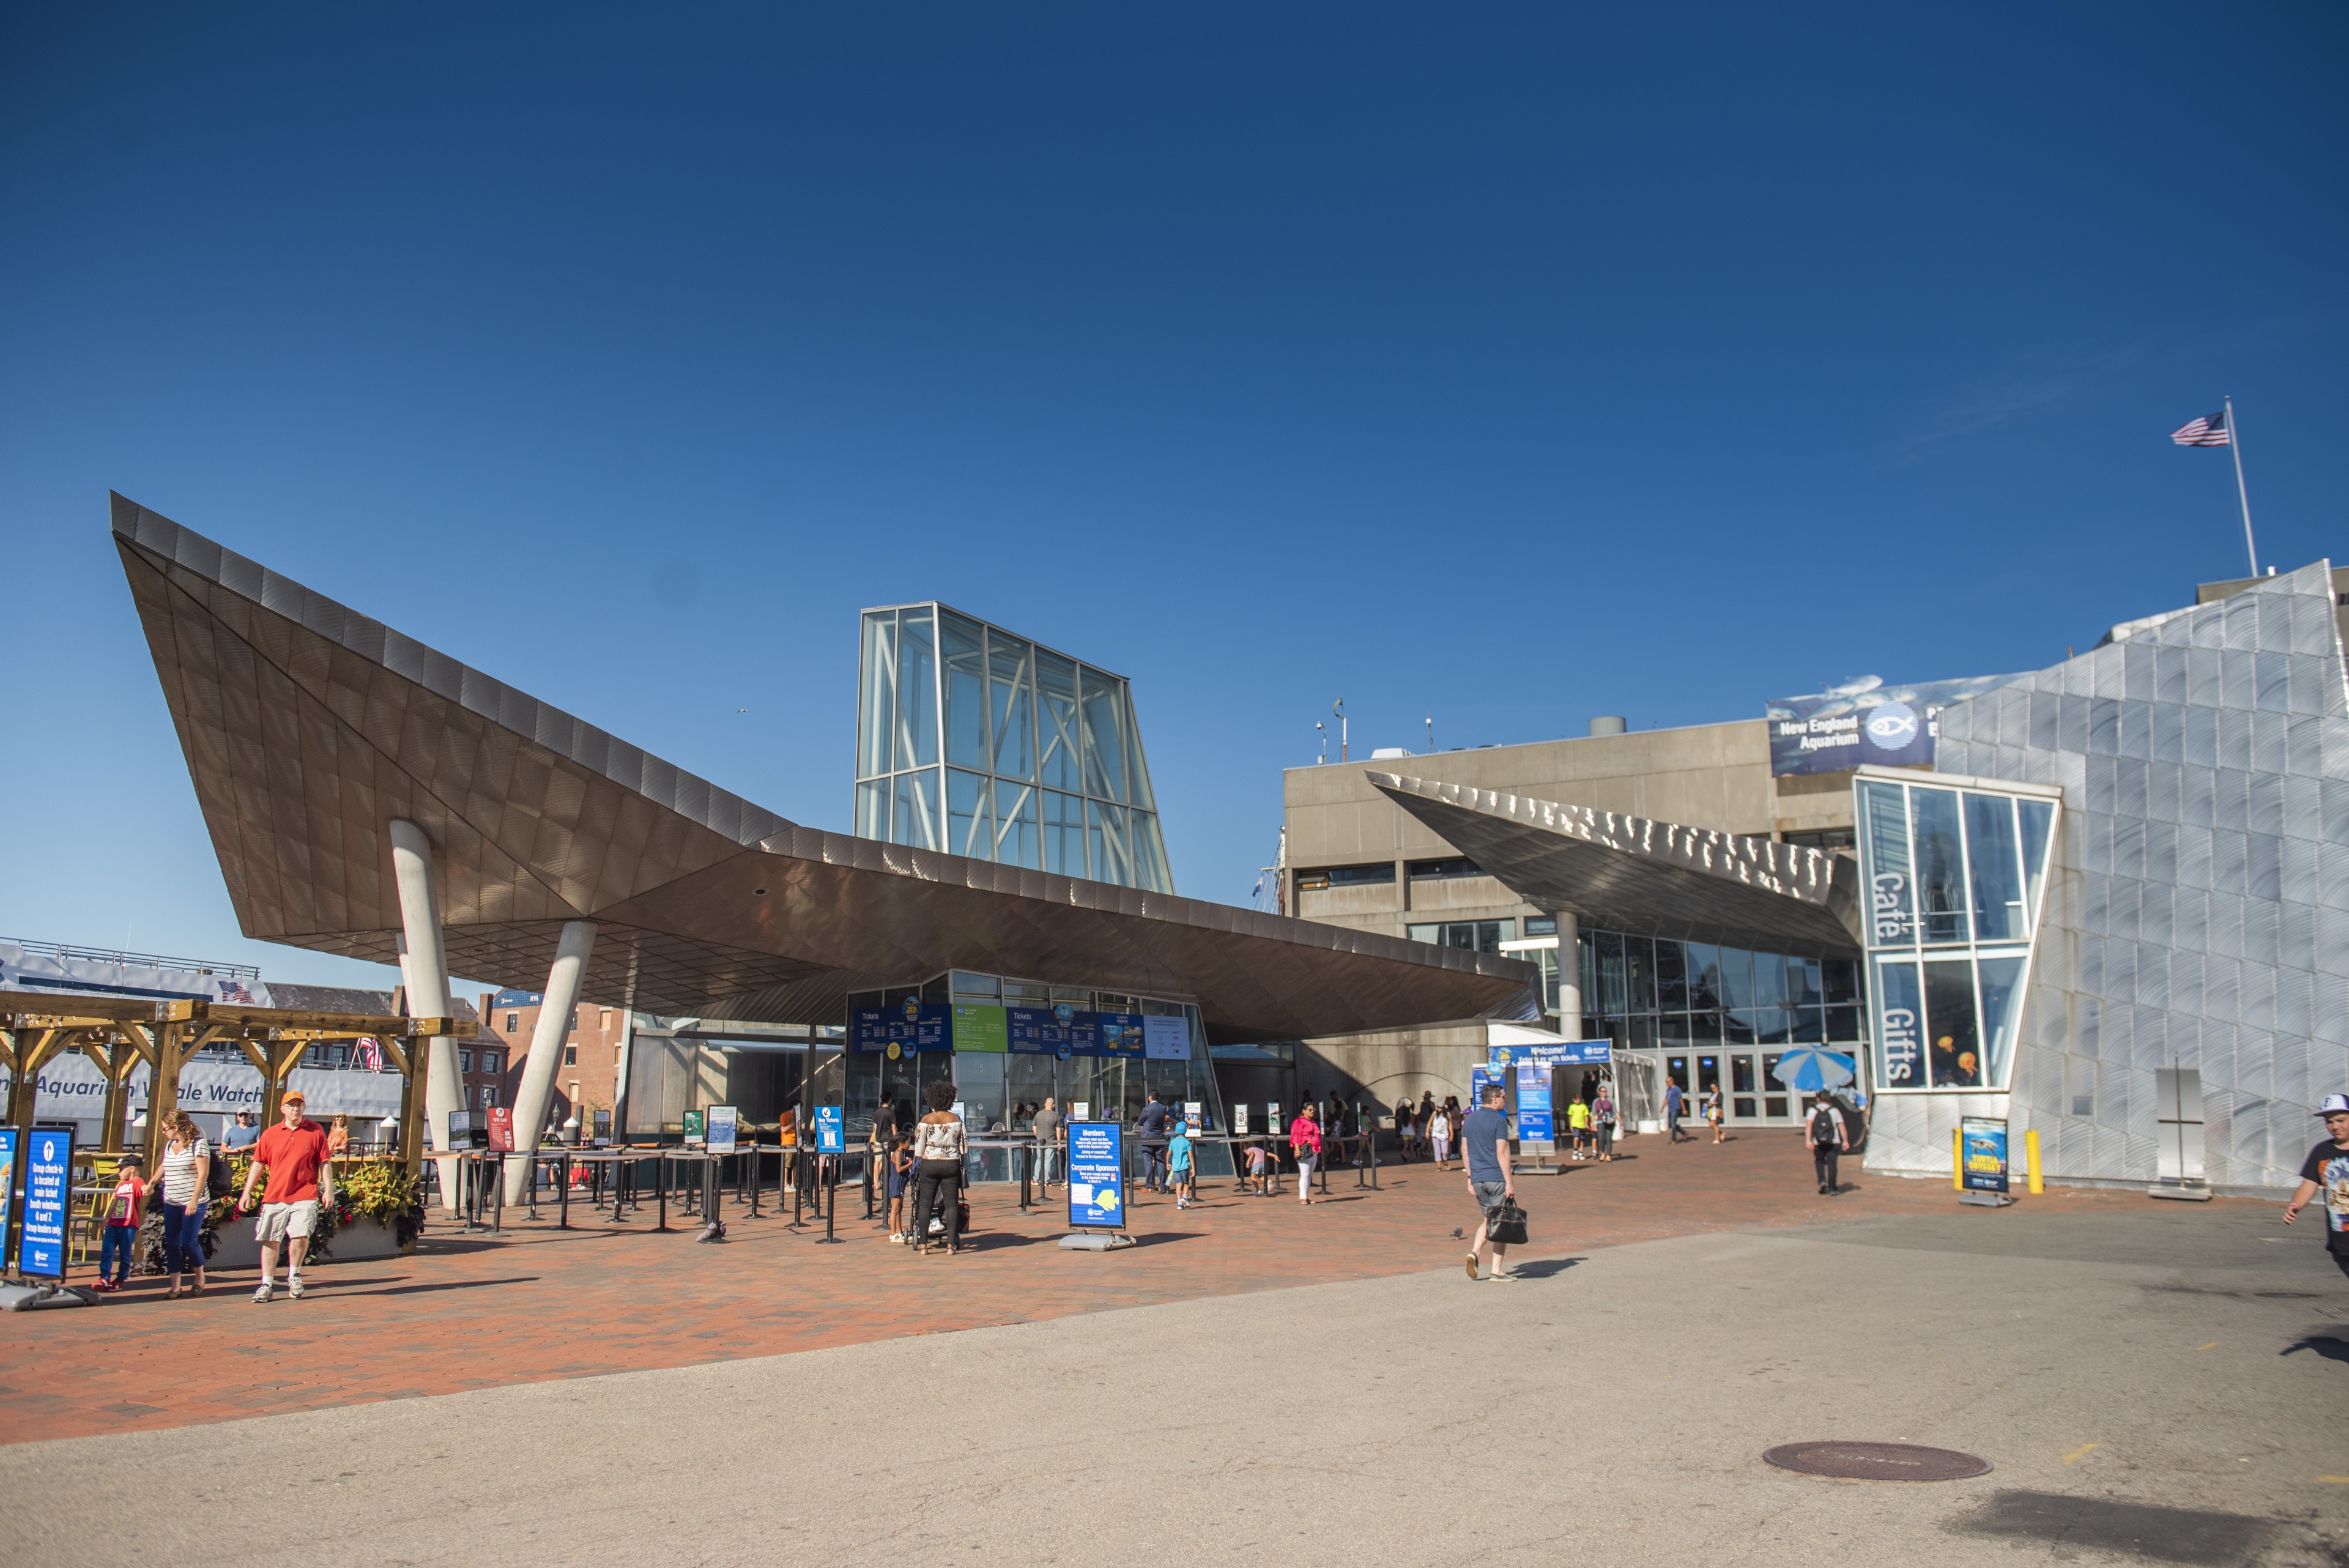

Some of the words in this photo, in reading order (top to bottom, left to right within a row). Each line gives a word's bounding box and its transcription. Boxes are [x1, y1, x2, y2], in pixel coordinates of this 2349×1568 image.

[1779, 721, 1808, 736] New
[1809, 715, 1859, 734] England
[1800, 732, 1860, 751] Aquarium
[1884, 1008, 1917, 1080] Gifts
[1531, 1045, 1567, 1055] Welcome!
[899, 1064, 902, 1072] 6
[979, 1063, 984, 1072] 5
[892, 1076, 910, 1084] Tickets
[1114, 1077, 1131, 1086] Ticets
[37, 1076, 135, 1098] Aquari
[143, 1081, 202, 1101] ale
[210, 1085, 263, 1103] Watch
[1972, 1154, 1998, 1164] TURTLE
[32, 1163, 44, 1174] Group
[45, 1164, 64, 1174] check-in
[1096, 1164, 1119, 1172] Sponsors
[1968, 1161, 2002, 1172] ODYSSEY
[34, 1175, 39, 1185] is
[39, 1176, 54, 1186] located
[54, 1176, 60, 1186] at
[34, 1187, 45, 1197] main
[45, 1188, 58, 1198] ticket
[116, 1183, 133, 1194] MARVEL
[29, 1198, 41, 1209] booth
[42, 1200, 61, 1211] windows
[35, 1211, 39, 1221] 6
[48, 1213, 52, 1222] 7.
[26, 1222, 37, 1234] Group
[37, 1224, 51, 1234] leaders
[52, 1225, 62, 1236] only.
